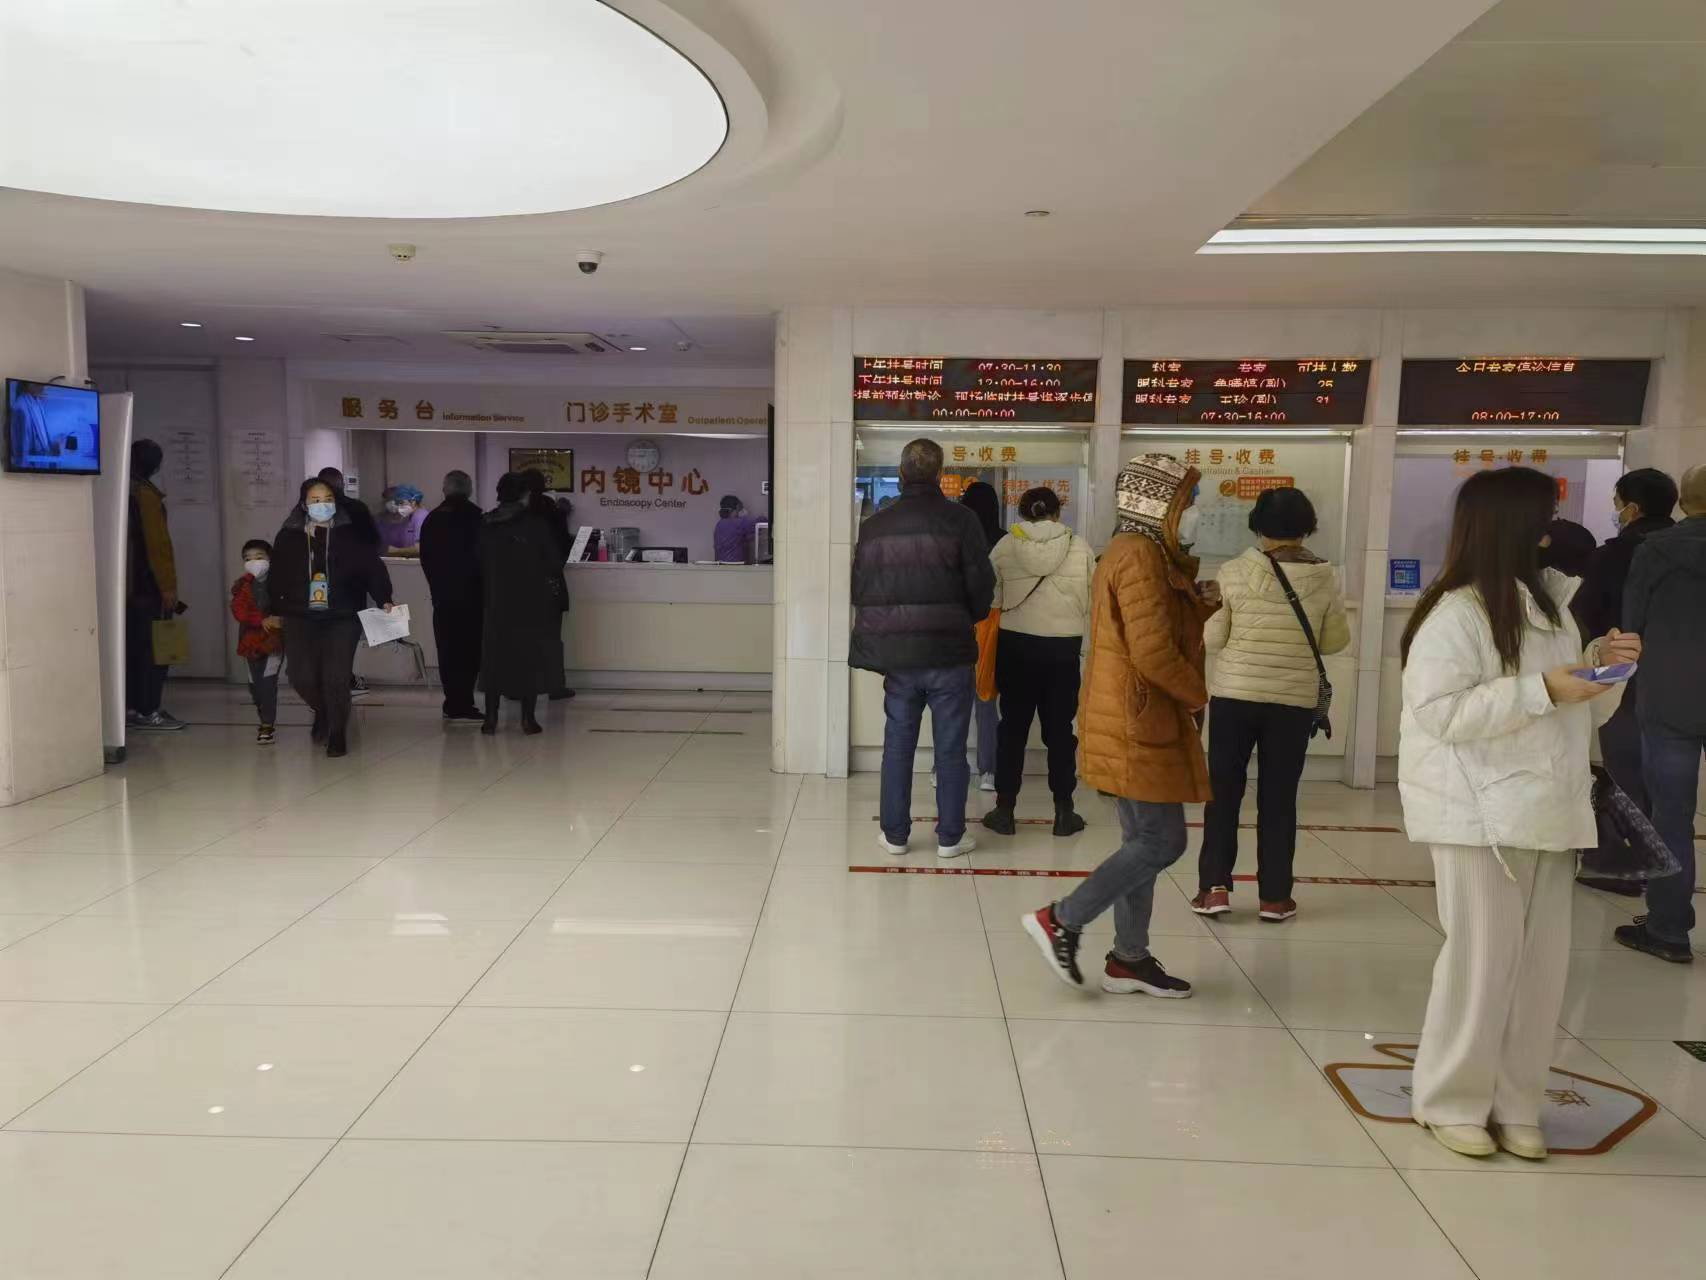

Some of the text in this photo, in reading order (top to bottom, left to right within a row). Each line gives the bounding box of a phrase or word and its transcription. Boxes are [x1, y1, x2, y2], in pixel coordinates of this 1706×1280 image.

[342, 397, 435, 421] 服务台
[565, 401, 678, 425] 门诊手术室
[688, 416, 735, 425] Outpatient
[580, 465, 709, 496] 内镜中心
[600, 498, 687, 509] Endoscopy Center
